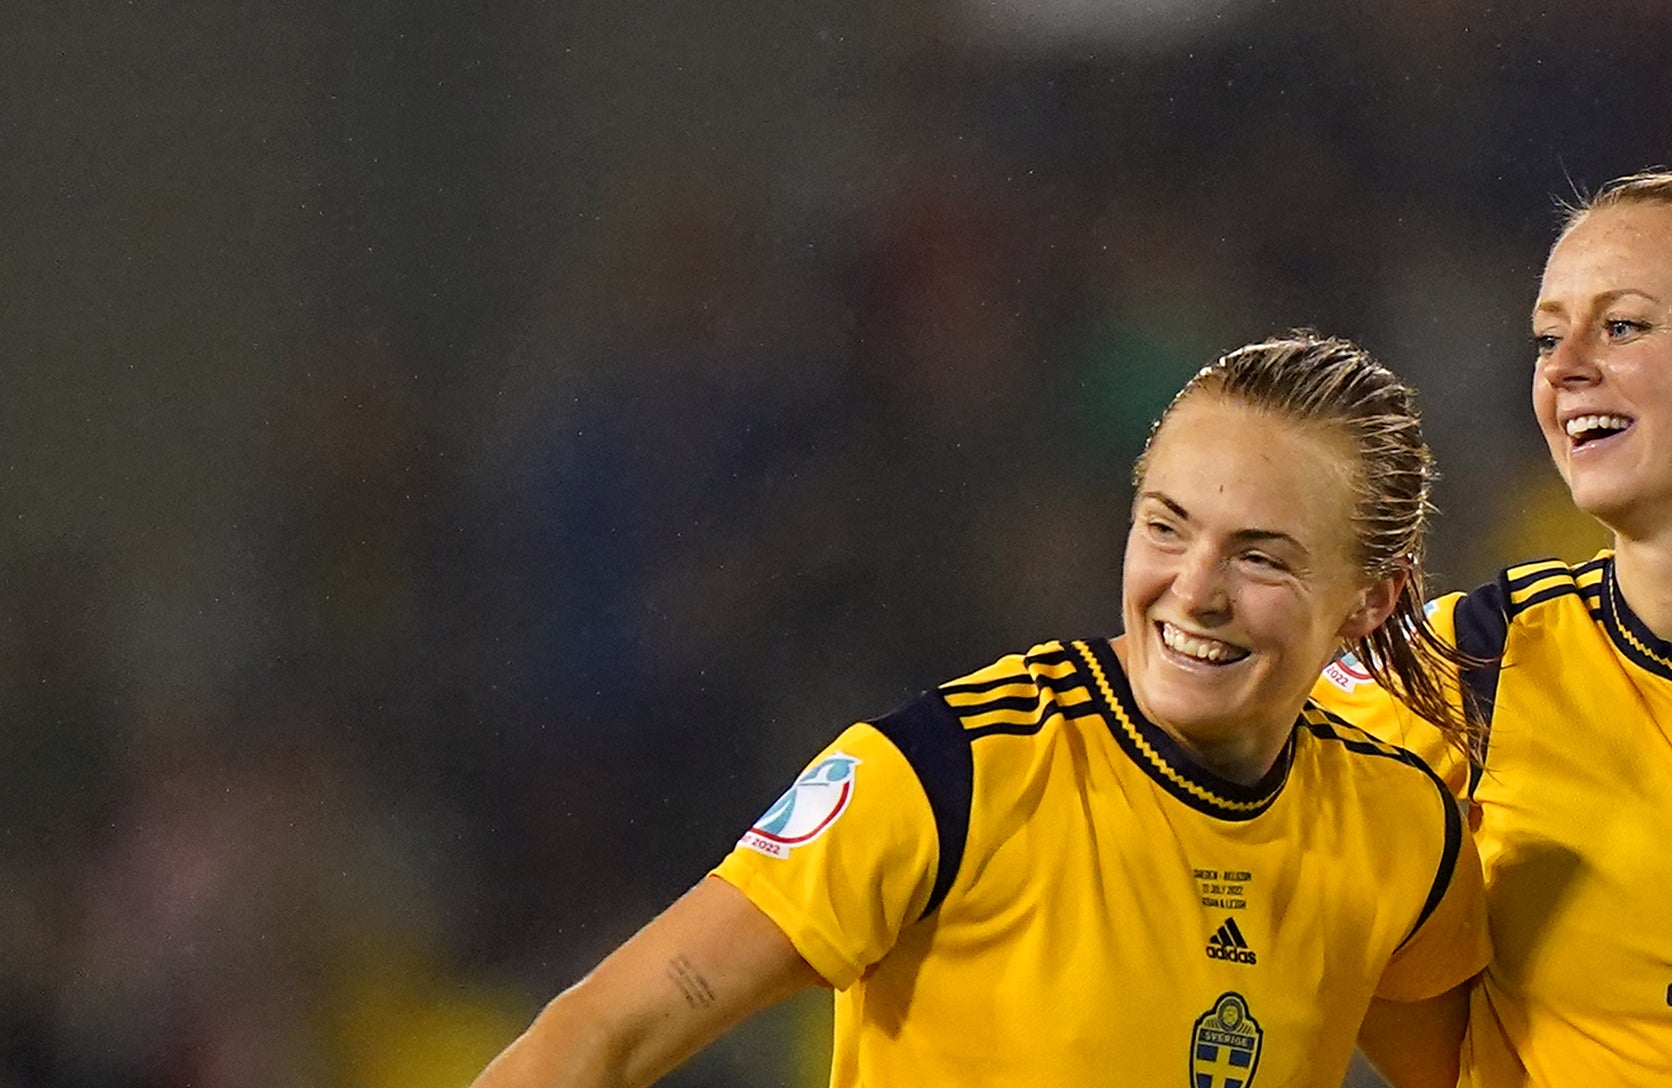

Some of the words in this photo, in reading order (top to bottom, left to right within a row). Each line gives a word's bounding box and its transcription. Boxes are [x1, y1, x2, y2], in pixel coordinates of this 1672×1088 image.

[1326, 666, 1349, 688] 2022
[752, 838, 780, 855] 2022
[1206, 944, 1257, 965] adidas
[1205, 1031, 1248, 1047] SVERIGE
